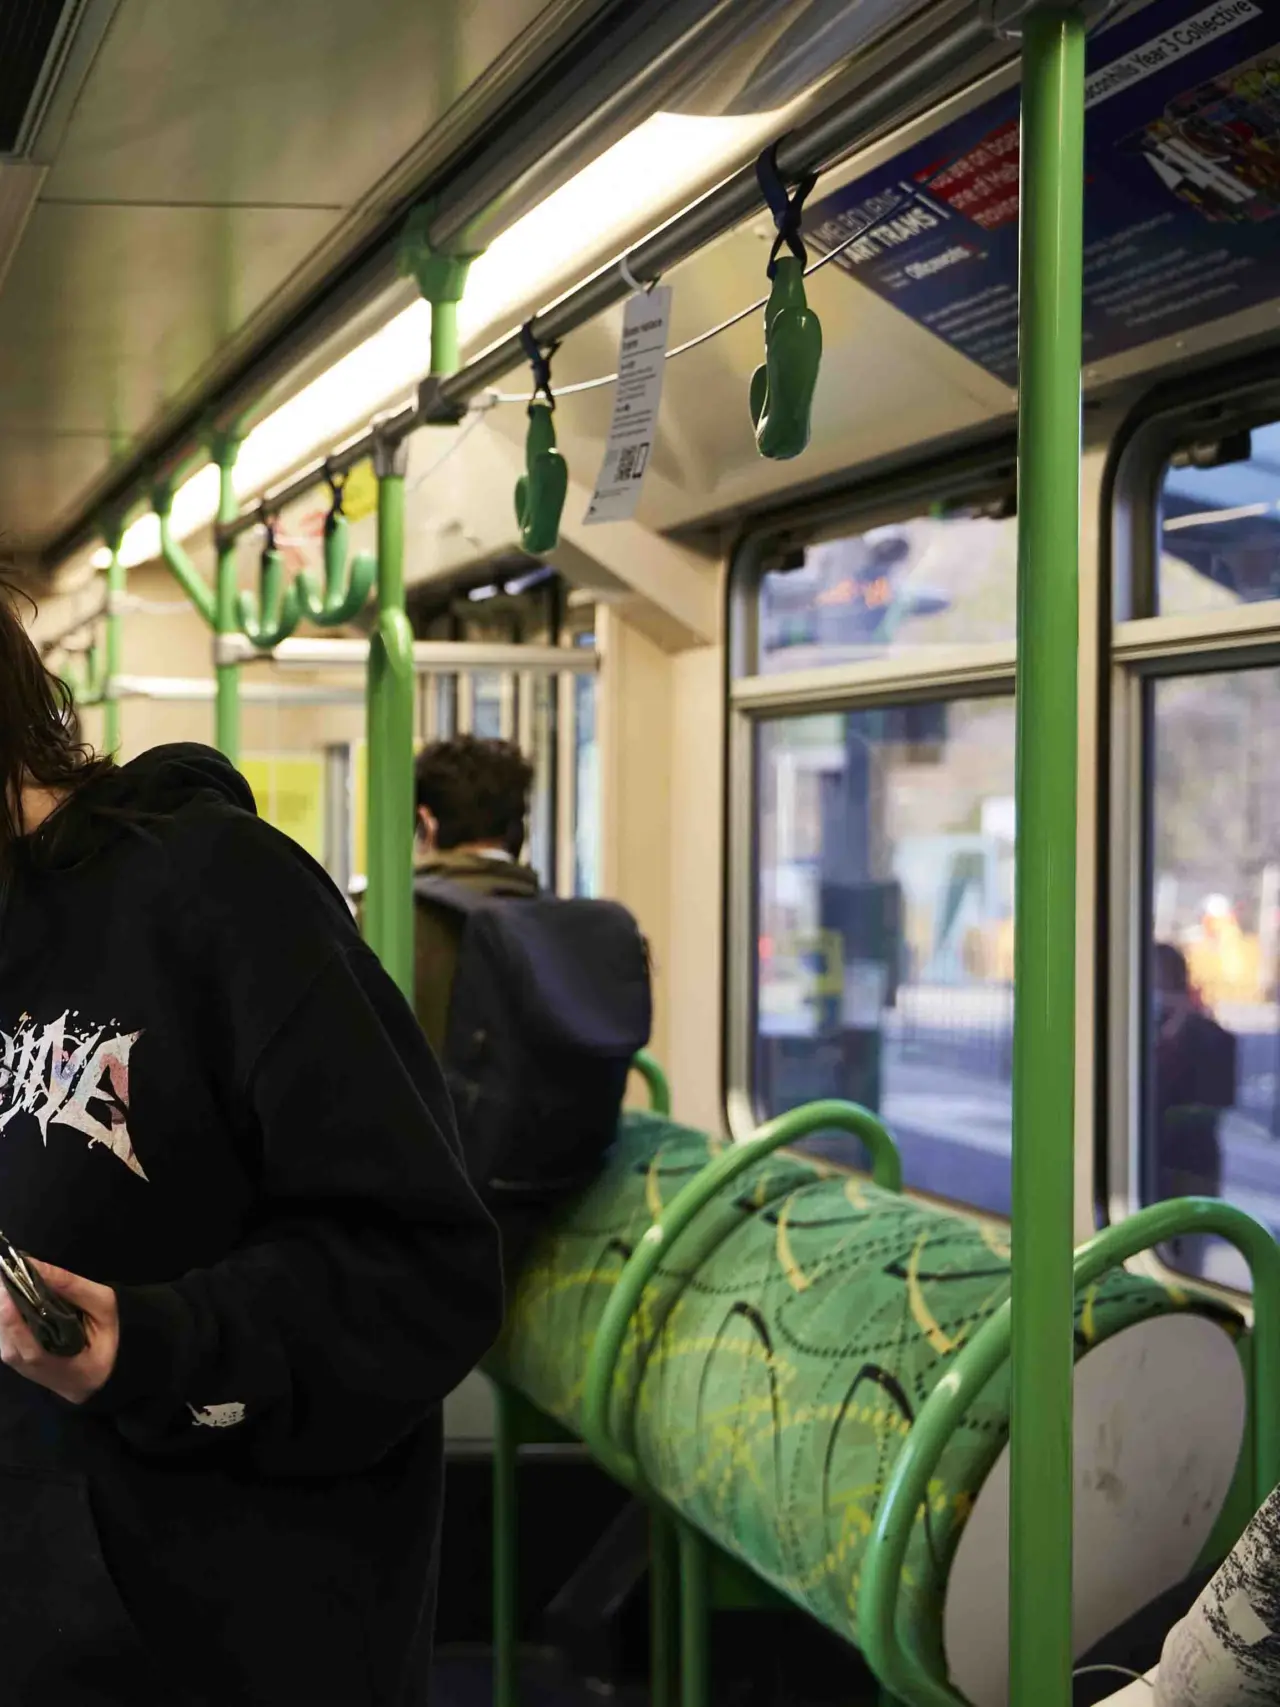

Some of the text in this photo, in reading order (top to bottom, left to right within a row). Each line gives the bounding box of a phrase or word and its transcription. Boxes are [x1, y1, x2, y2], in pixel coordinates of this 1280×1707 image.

[1129, 44, 1170, 69] Year
[1162, 37, 1180, 53] 3
[1173, 0, 1252, 46] Collective
[843, 234, 883, 265] ART
[870, 206, 939, 248] TRAMS
